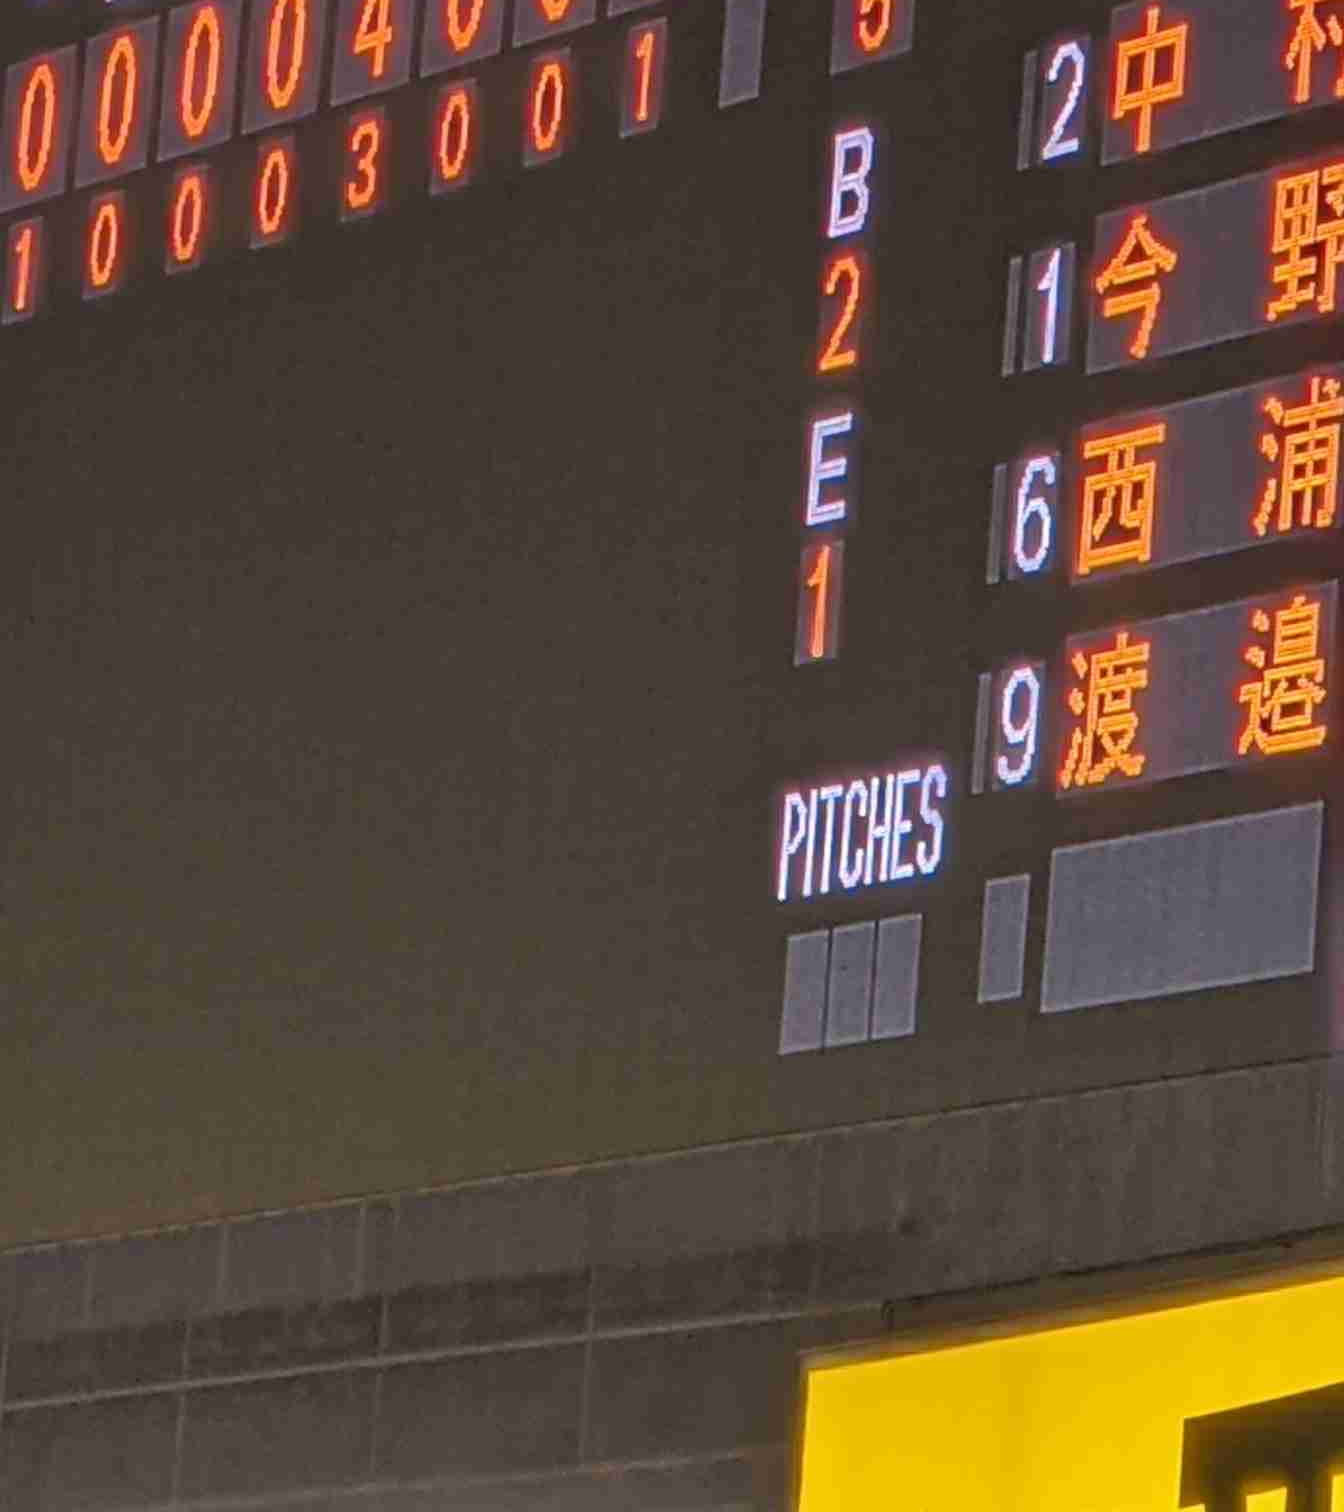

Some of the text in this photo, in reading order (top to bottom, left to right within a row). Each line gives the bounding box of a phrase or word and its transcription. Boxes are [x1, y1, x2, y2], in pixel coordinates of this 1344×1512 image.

[17, 63, 54, 192] 0
[97, 35, 136, 164] 0
[182, 4, 220, 137] 0
[1042, 42, 1085, 159] 2
[14, 226, 33, 312] 1
[90, 203, 118, 288] 0
[173, 175, 202, 262] 0
[259, 149, 289, 235] 0
[346, 119, 380, 209] 3
[439, 89, 469, 180] 0
[533, 62, 563, 152] 0
[635, 31, 654, 121] 1
[827, 126, 874, 239] B
[818, 257, 861, 372] 2
[1037, 247, 1061, 364] 1
[804, 411, 854, 526] E
[1012, 455, 1054, 573] 6
[806, 544, 831, 659] 1
[996, 666, 1040, 786] 9
[777, 764, 947, 903] PITCHES
